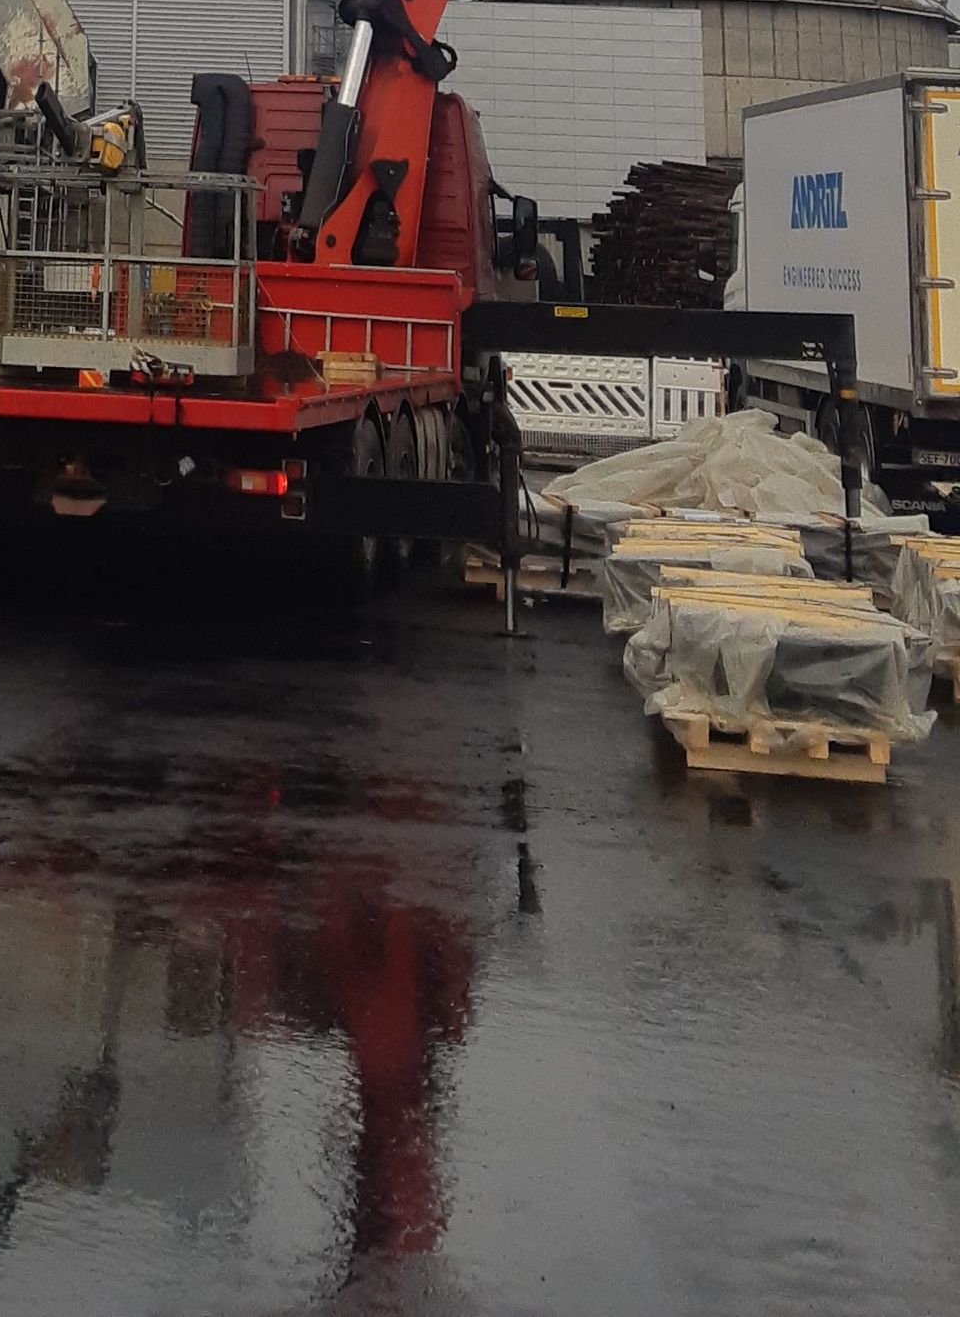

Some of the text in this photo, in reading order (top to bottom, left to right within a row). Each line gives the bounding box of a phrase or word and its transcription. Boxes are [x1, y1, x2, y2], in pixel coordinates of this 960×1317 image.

[791, 171, 848, 229] ANDRITZ
[783, 264, 862, 292] ENGINEERED SUCCESS
[891, 499, 946, 511] SCANIA
